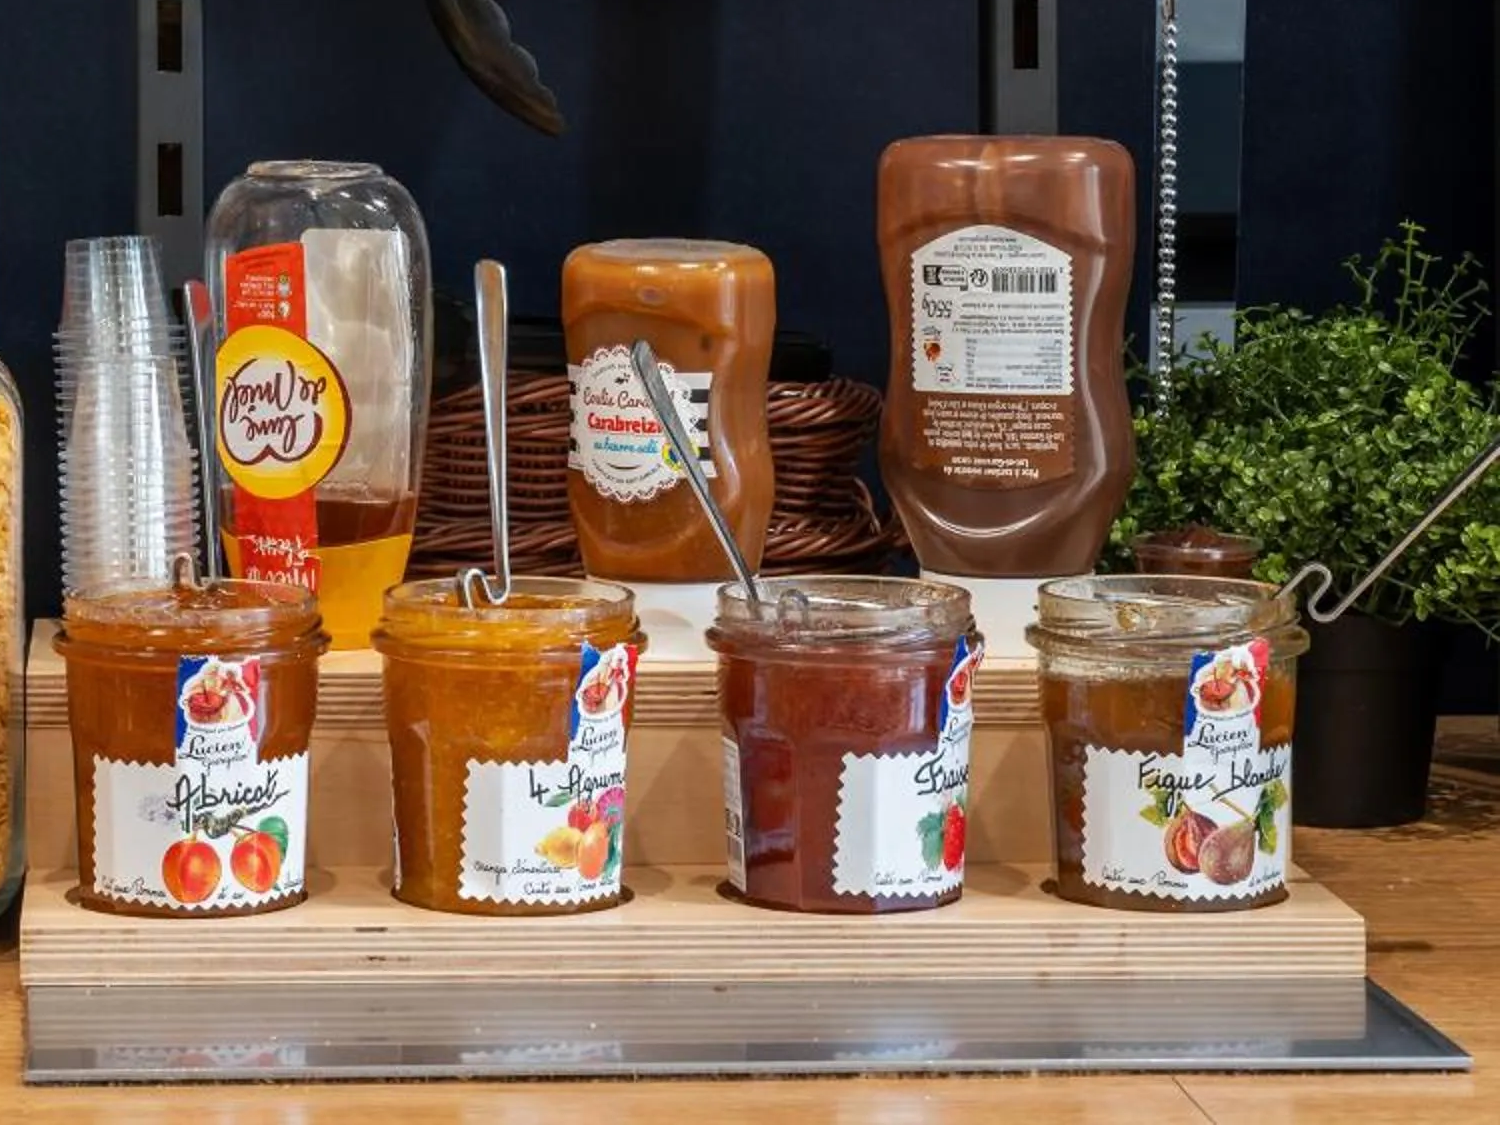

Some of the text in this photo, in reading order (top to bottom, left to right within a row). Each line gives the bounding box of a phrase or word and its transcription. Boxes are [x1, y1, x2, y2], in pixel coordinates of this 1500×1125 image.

[922, 293, 953, 319] 550g
[298, 377, 327, 406] de
[529, 769, 550, 804] 4
[1138, 755, 1217, 817] Figue
